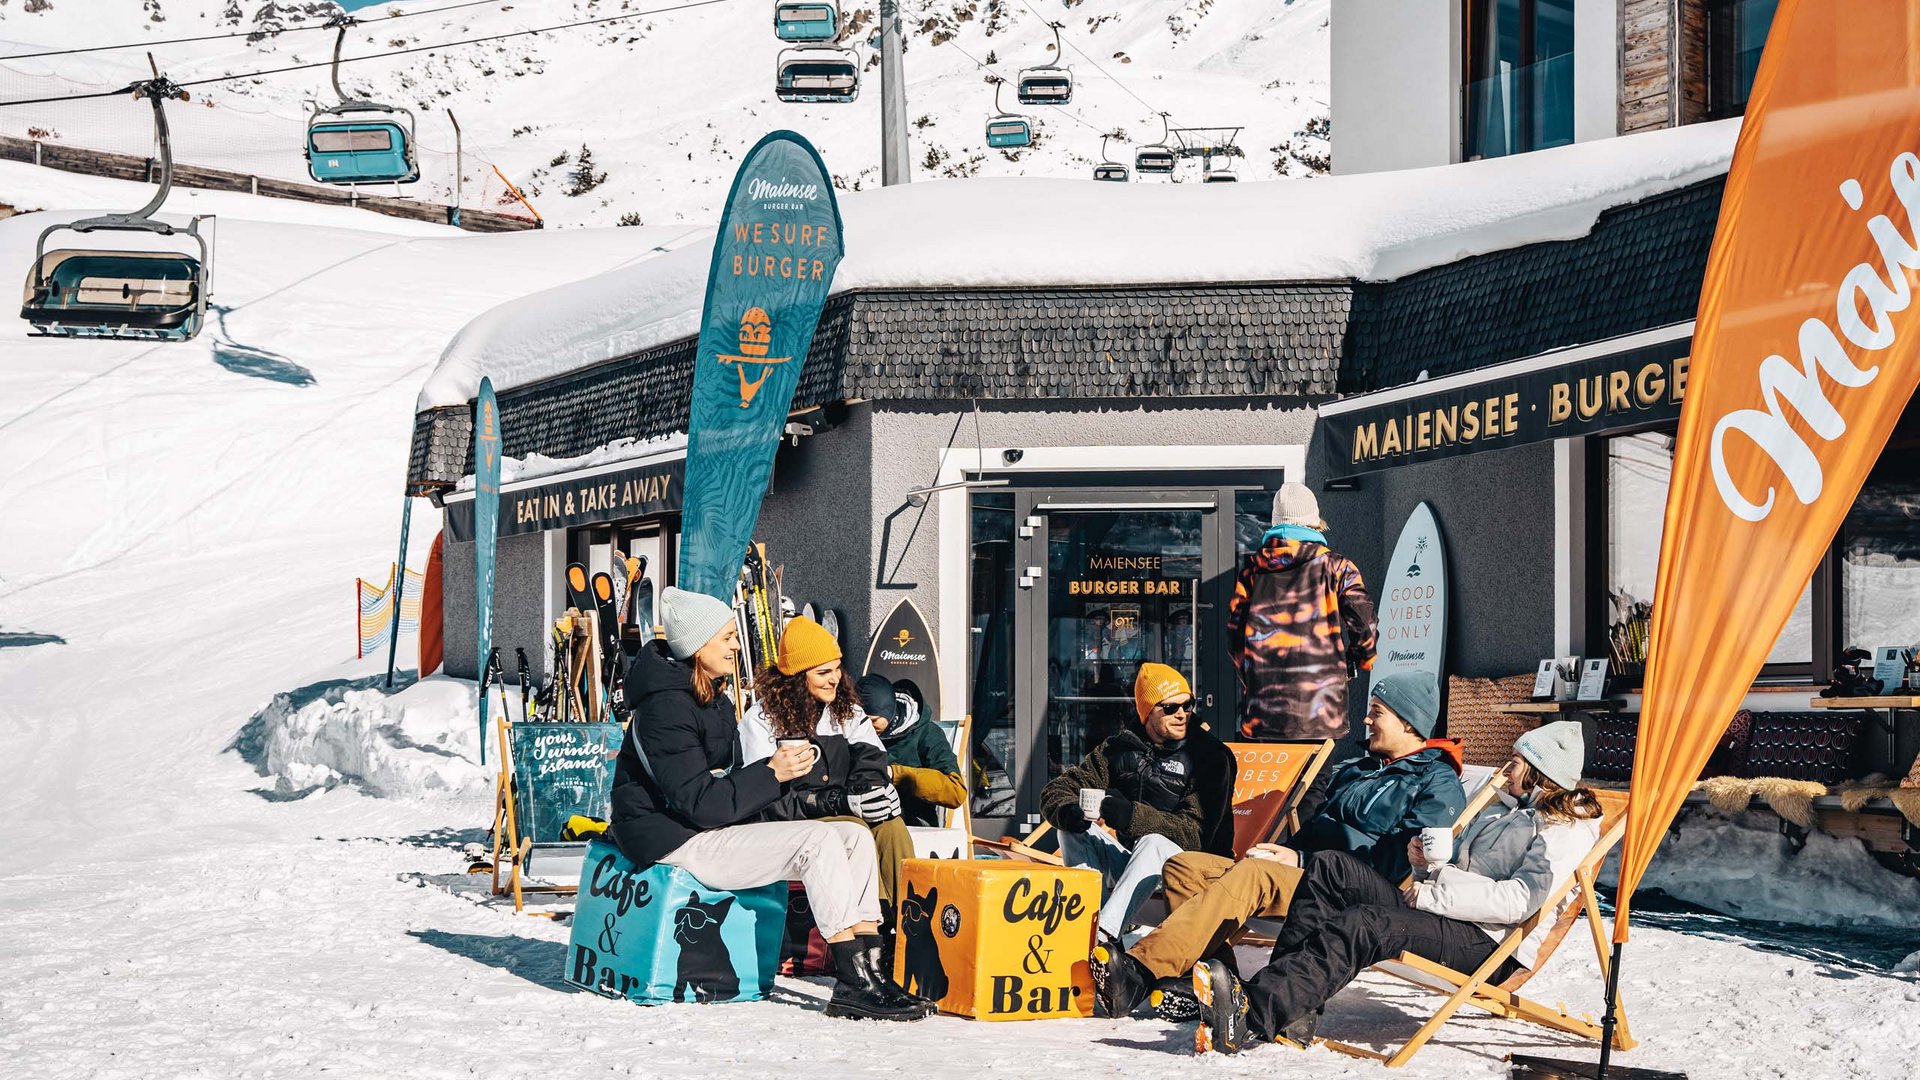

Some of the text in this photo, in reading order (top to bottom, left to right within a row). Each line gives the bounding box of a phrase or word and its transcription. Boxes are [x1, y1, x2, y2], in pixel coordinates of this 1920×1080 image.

[748, 177, 818, 200] Maiensee
[735, 223, 828, 247] WE SURF
[733, 255, 824, 281] BURGER
[1710, 152, 1920, 521] Maie
[1352, 356, 1690, 464] MAIENSEE BURGE
[517, 474, 671, 524] EAT IN & TAKE AWAY
[1090, 557, 1160, 569] MAIENSEE
[1069, 581, 1180, 595] BURGER BAR
[1391, 585, 1435, 602] GOOD
[1390, 605, 1432, 620] VIBES
[1388, 624, 1431, 640] ONLY
[880, 649, 927, 662] Maiensee
[1388, 650, 1425, 662] Maiensee
[533, 733, 576, 760] your
[547, 741, 608, 759] winter
[540, 755, 601, 777] island
[1236, 769, 1280, 782] IBES
[1234, 787, 1272, 800] NLY
[590, 853, 652, 917] Cafe
[1003, 877, 1085, 935] Cafe
[598, 912, 622, 956] &
[1022, 934, 1054, 975] &
[572, 943, 639, 996] Bar
[988, 975, 1081, 1014] Bar
